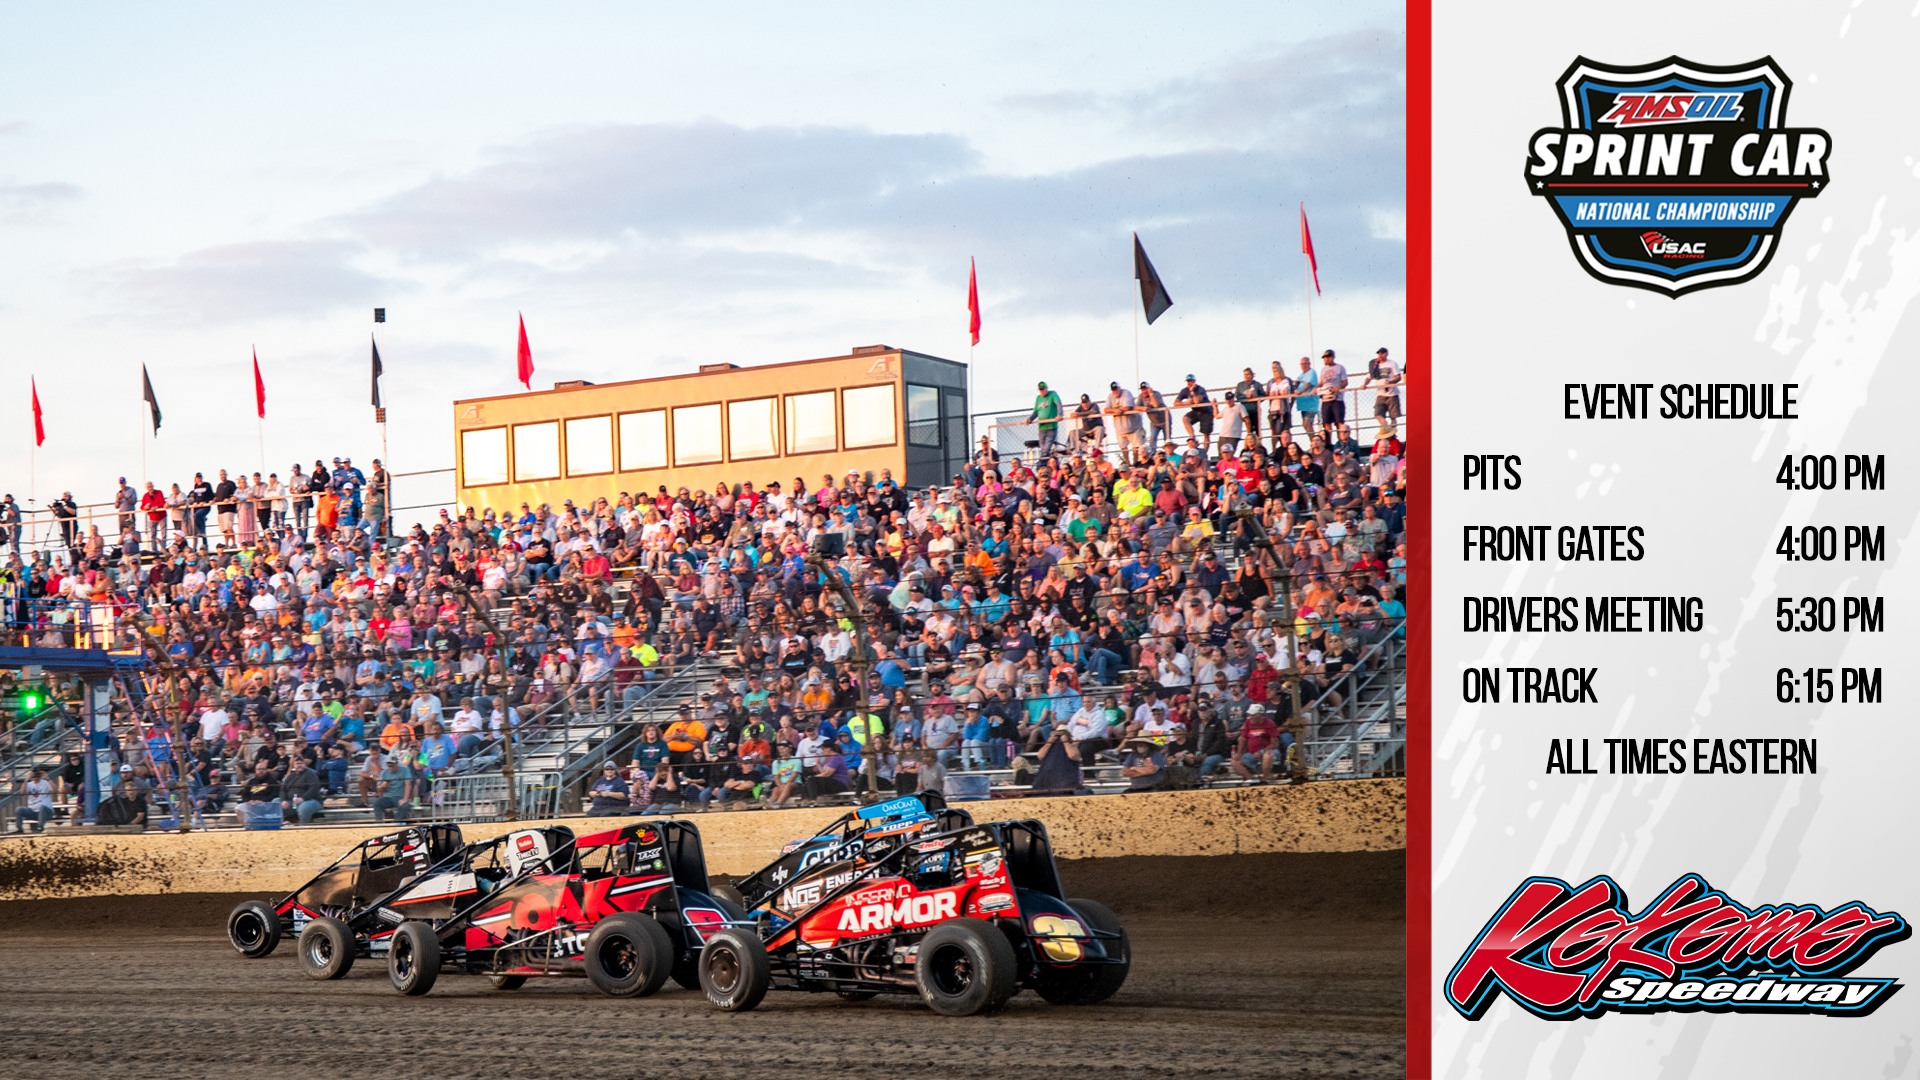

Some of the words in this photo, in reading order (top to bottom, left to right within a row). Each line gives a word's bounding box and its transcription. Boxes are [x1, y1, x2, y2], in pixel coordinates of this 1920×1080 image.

[783, 880, 824, 910] NOS
[846, 885, 912, 906] INFERNO
[837, 890, 957, 933] ARMOR
